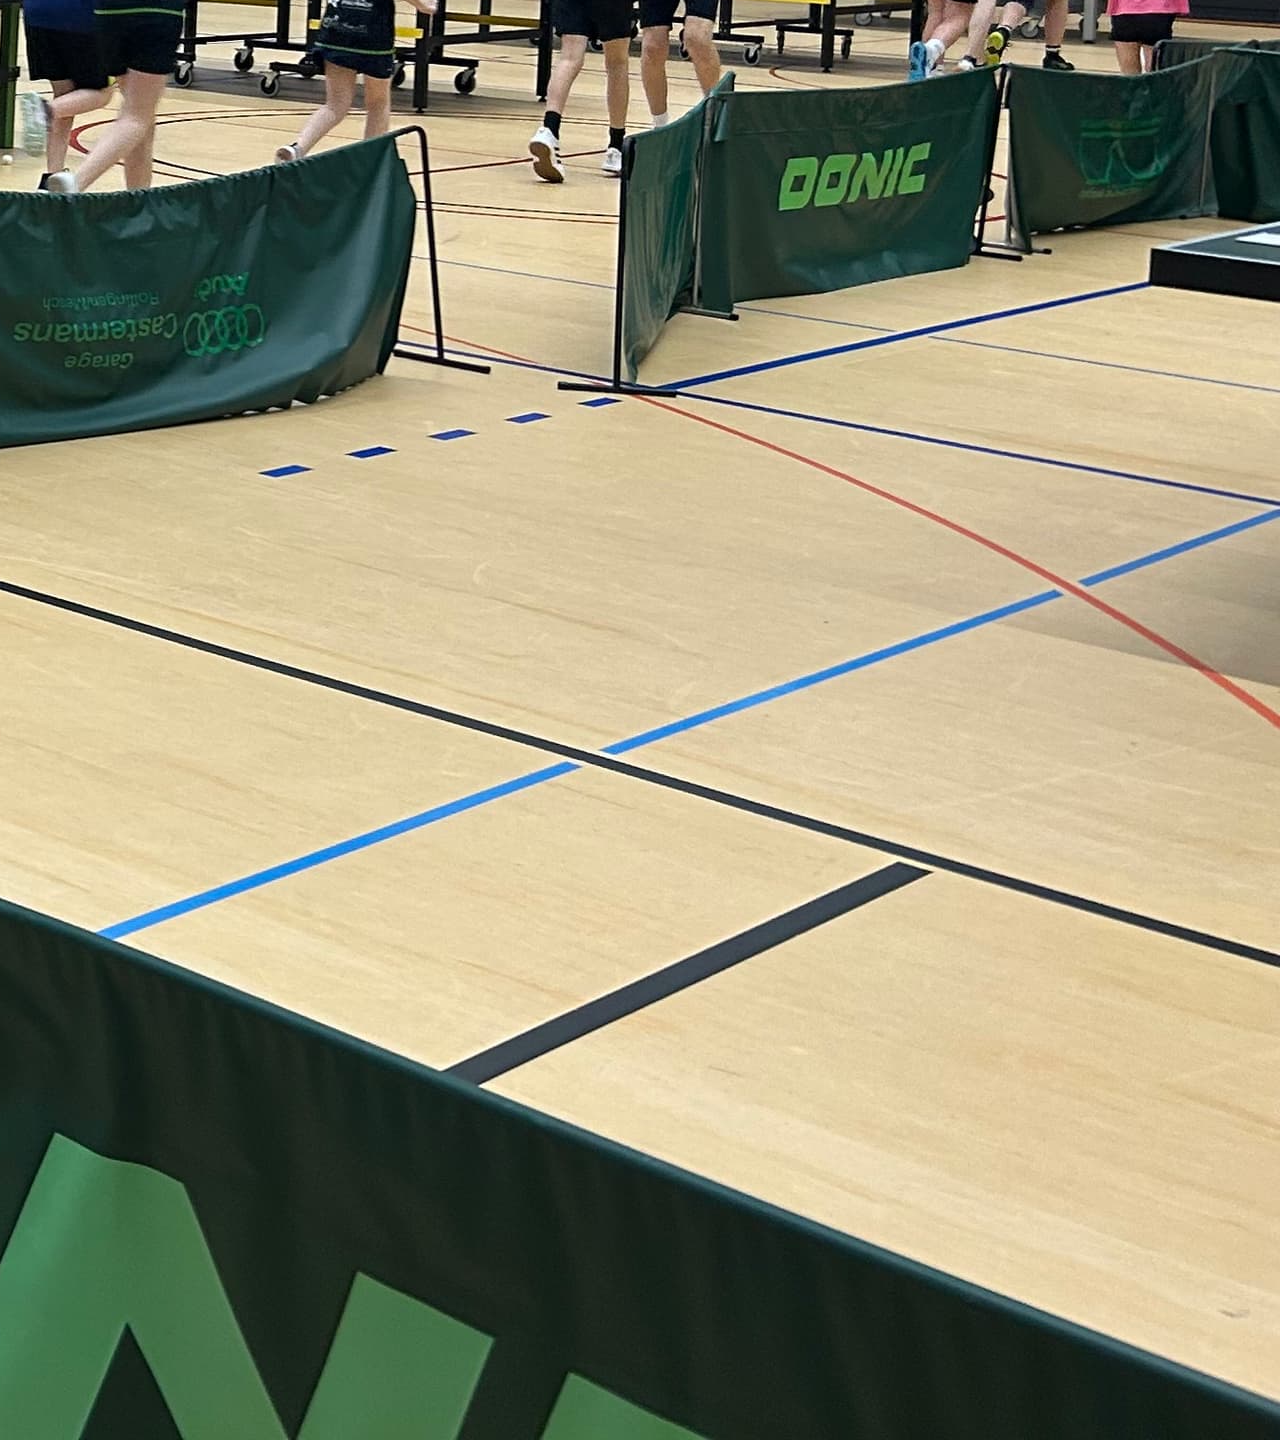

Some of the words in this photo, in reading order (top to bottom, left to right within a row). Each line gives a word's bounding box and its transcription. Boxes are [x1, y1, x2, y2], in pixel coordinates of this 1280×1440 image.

[779, 142, 930, 211] DONIC
[14, 313, 178, 343] Castermans
[64, 352, 134, 369] Garage
